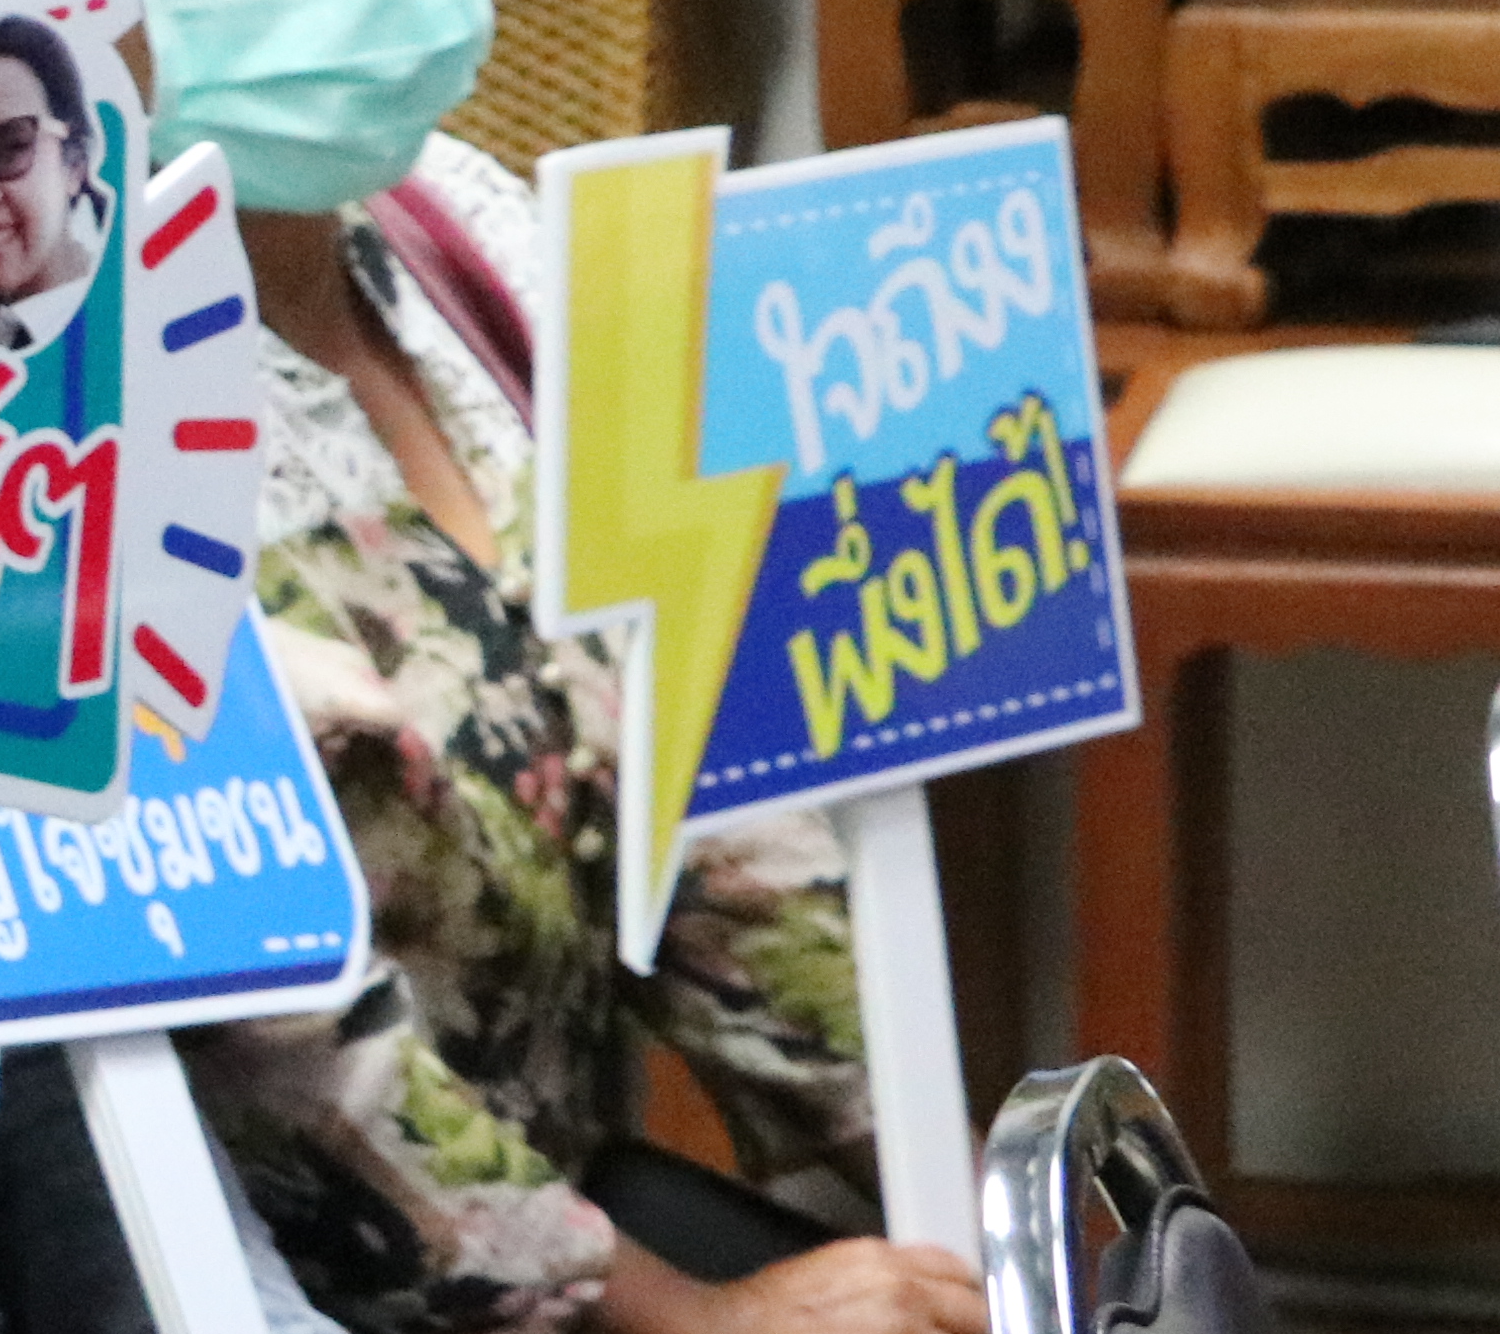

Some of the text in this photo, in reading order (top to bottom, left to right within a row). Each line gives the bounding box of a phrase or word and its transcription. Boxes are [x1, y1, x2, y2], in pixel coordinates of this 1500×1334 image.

[754, 186, 1056, 477] ใจถึง
[786, 394, 1092, 760] พึ่งได้!
